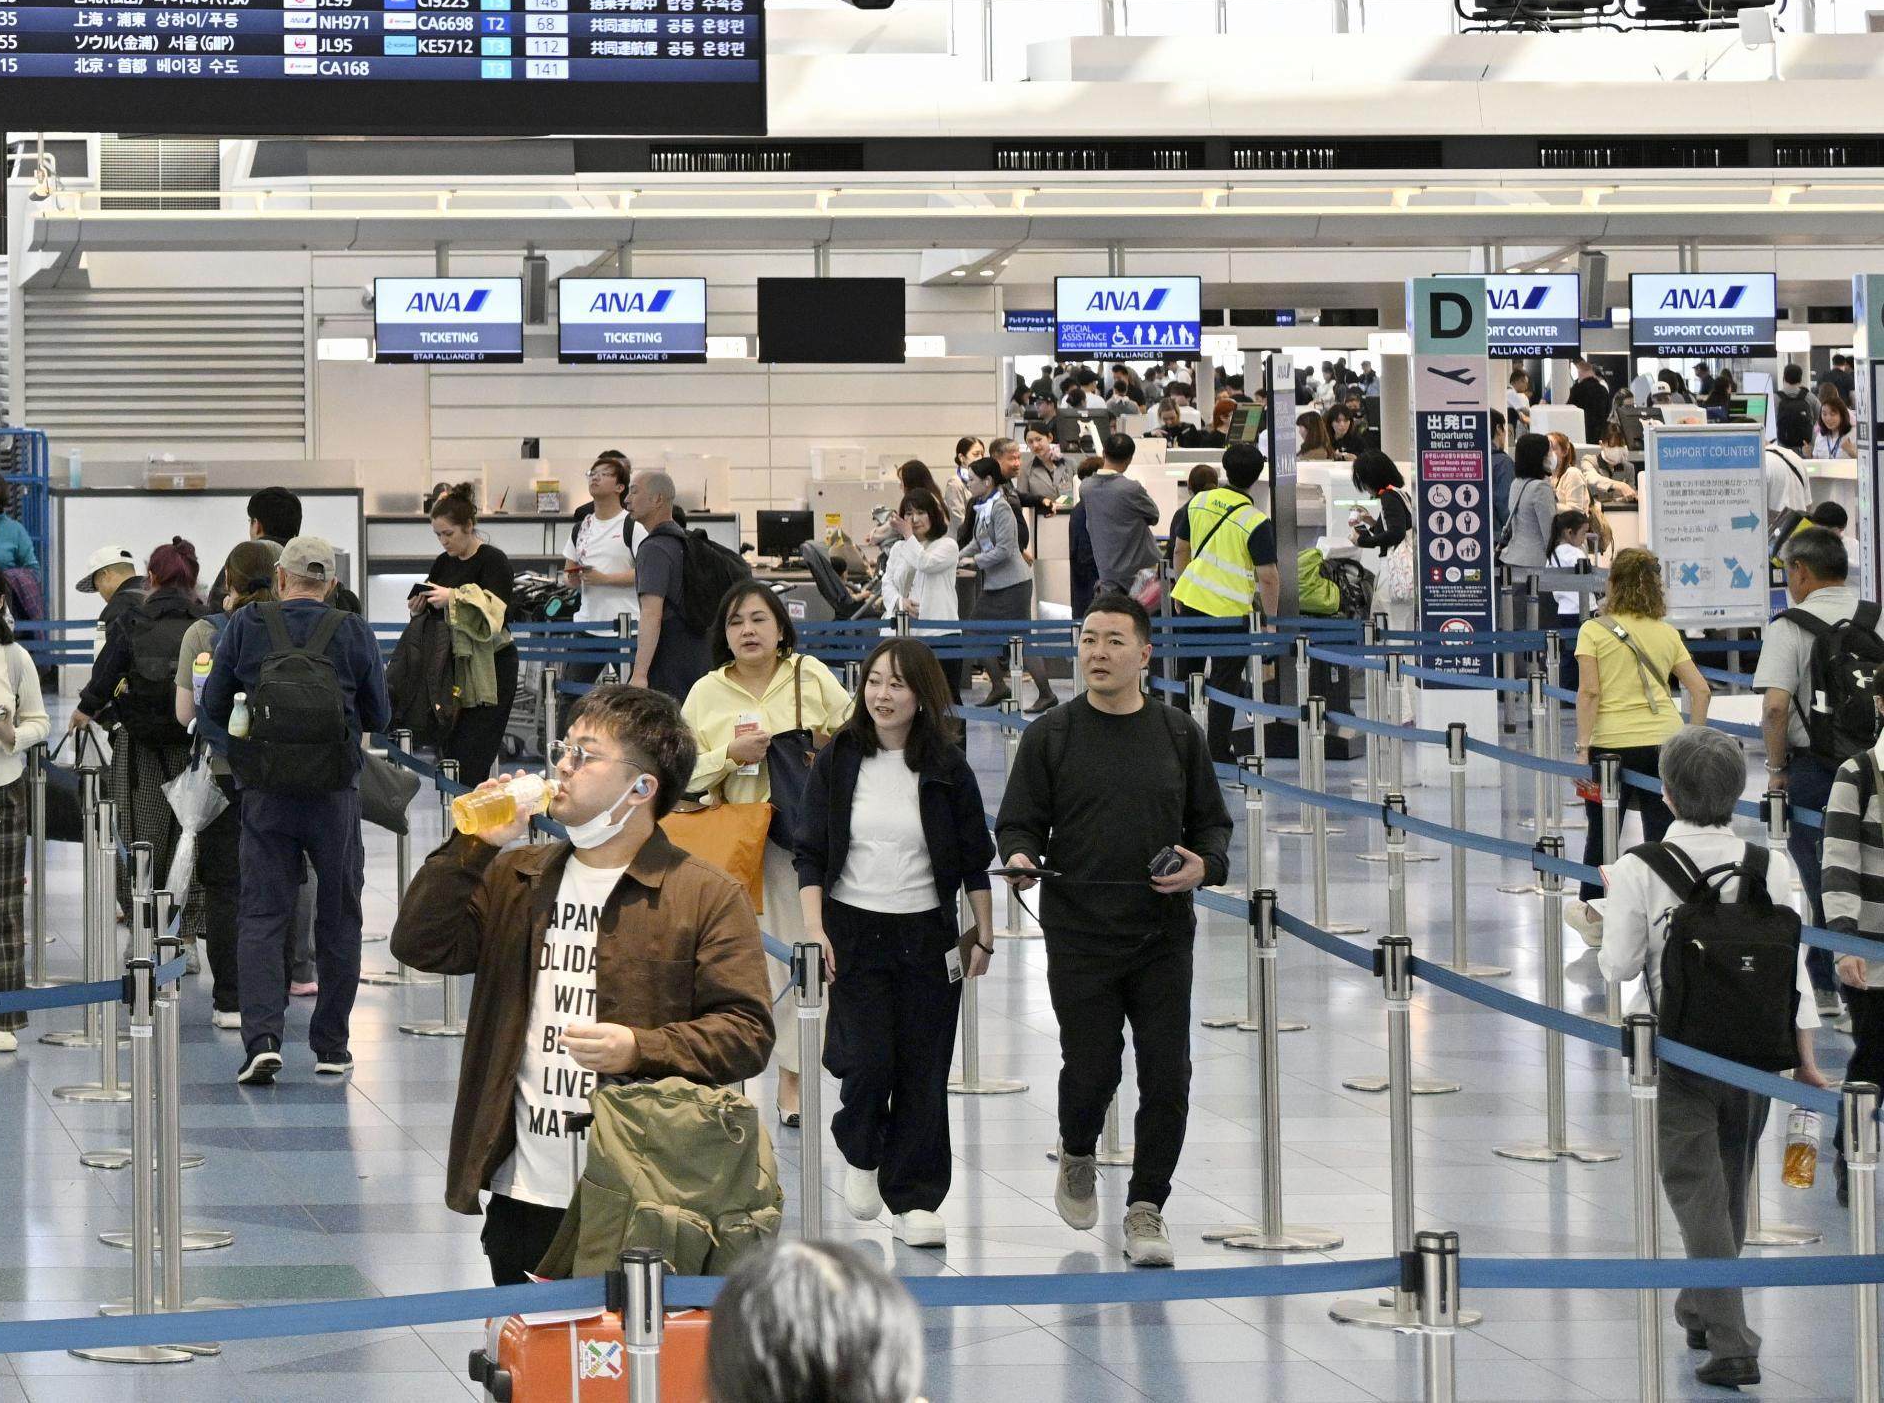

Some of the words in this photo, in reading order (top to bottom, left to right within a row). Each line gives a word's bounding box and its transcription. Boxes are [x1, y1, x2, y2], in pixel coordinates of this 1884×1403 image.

[486, 17, 505, 31] T2
[314, 57, 370, 76] CA168
[406, 293, 461, 312] ANA
[590, 293, 645, 312] ANA
[1086, 291, 1140, 311] ANA
[1487, 289, 1519, 309] NA
[1660, 289, 1718, 309] ANA
[1430, 292, 1473, 338] D
[1062, 324, 1091, 333] SPECIAL
[1507, 326, 1557, 336] COUNTER
[1653, 325, 1701, 336] SUPPORT
[1704, 325, 1754, 336] COUNTER
[420, 332, 478, 343] TICKETING
[604, 332, 662, 343] TICKETING
[1062, 333, 1107, 342] ASSISTANCE
[1490, 347, 1541, 355] ALLIANCE
[1658, 346, 1684, 354] STAR
[1686, 346, 1737, 354] ALLIANCE
[1427, 415, 1476, 430] 出発口
[1431, 431, 1474, 441] Departures
[1662, 447, 1707, 457] SUPPORT
[1709, 446, 1755, 457] COUNTER
[1434, 657, 1481, 666] カート禁止
[548, 901, 605, 932] APAN
[538, 942, 597, 974] OLIDA
[554, 984, 597, 1016] WIT
[543, 1066, 594, 1099] LIVE
